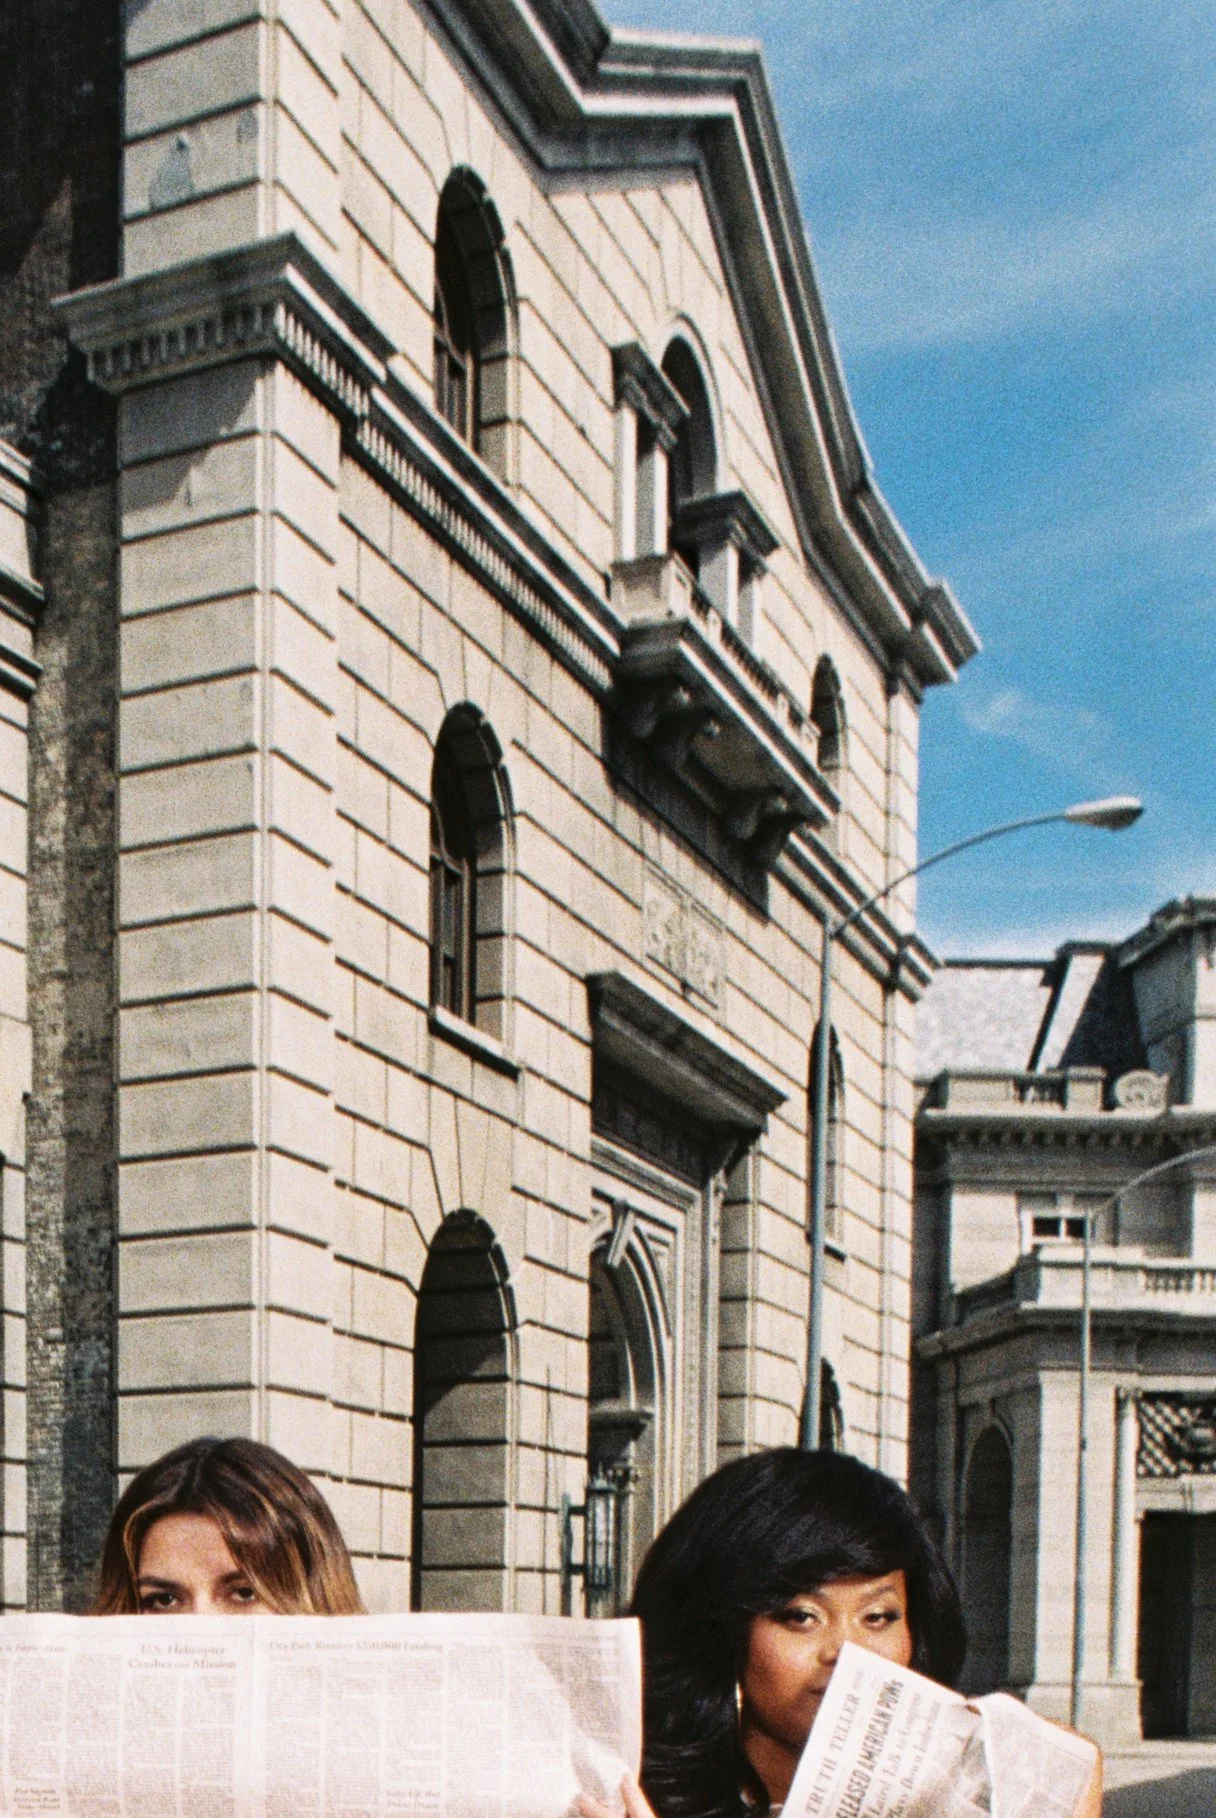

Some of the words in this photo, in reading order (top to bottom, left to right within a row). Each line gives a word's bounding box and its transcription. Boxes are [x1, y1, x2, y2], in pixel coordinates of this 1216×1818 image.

[805, 1758, 837, 1818] TRUTH
[829, 1694, 860, 1758] TELLER
[856, 1706, 893, 1773] AMERICAN
[878, 1678, 904, 1712] POWs
